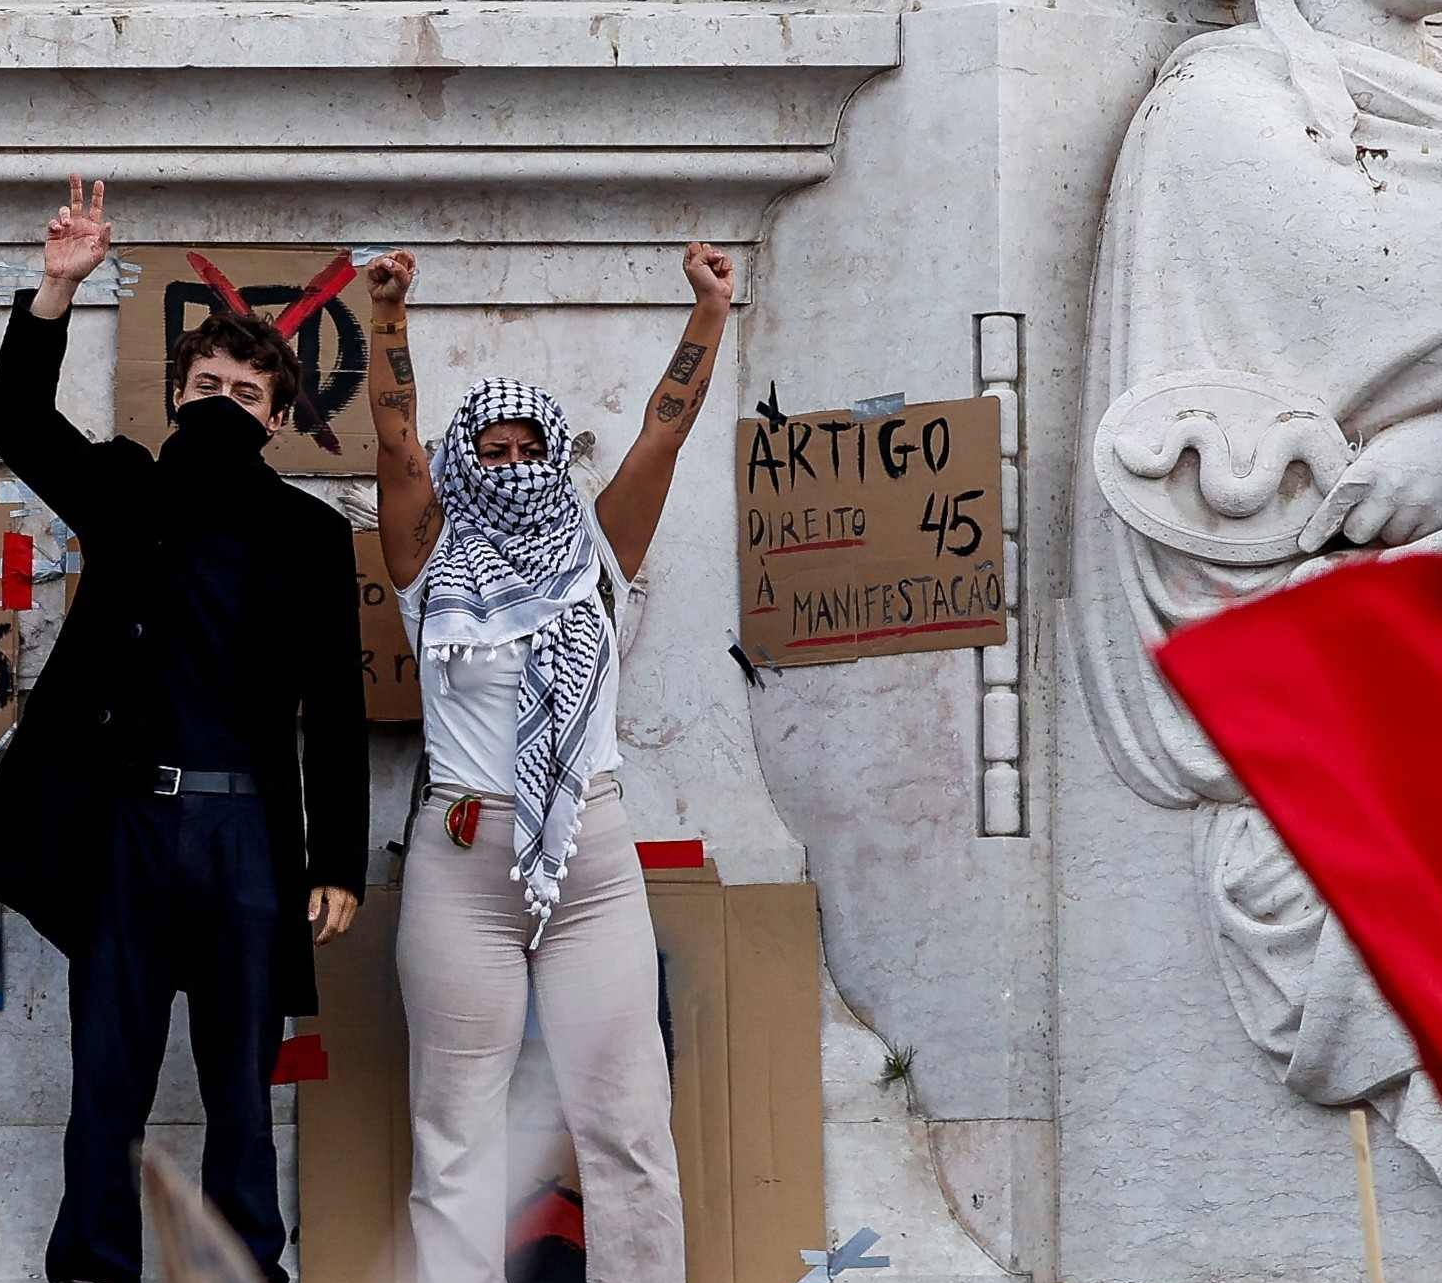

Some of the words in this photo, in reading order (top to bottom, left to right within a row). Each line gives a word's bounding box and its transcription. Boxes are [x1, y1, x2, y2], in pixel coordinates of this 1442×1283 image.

[746, 416, 952, 496] ARTIGO
[747, 506, 866, 553] DIREITO
[917, 489, 985, 560] 45
